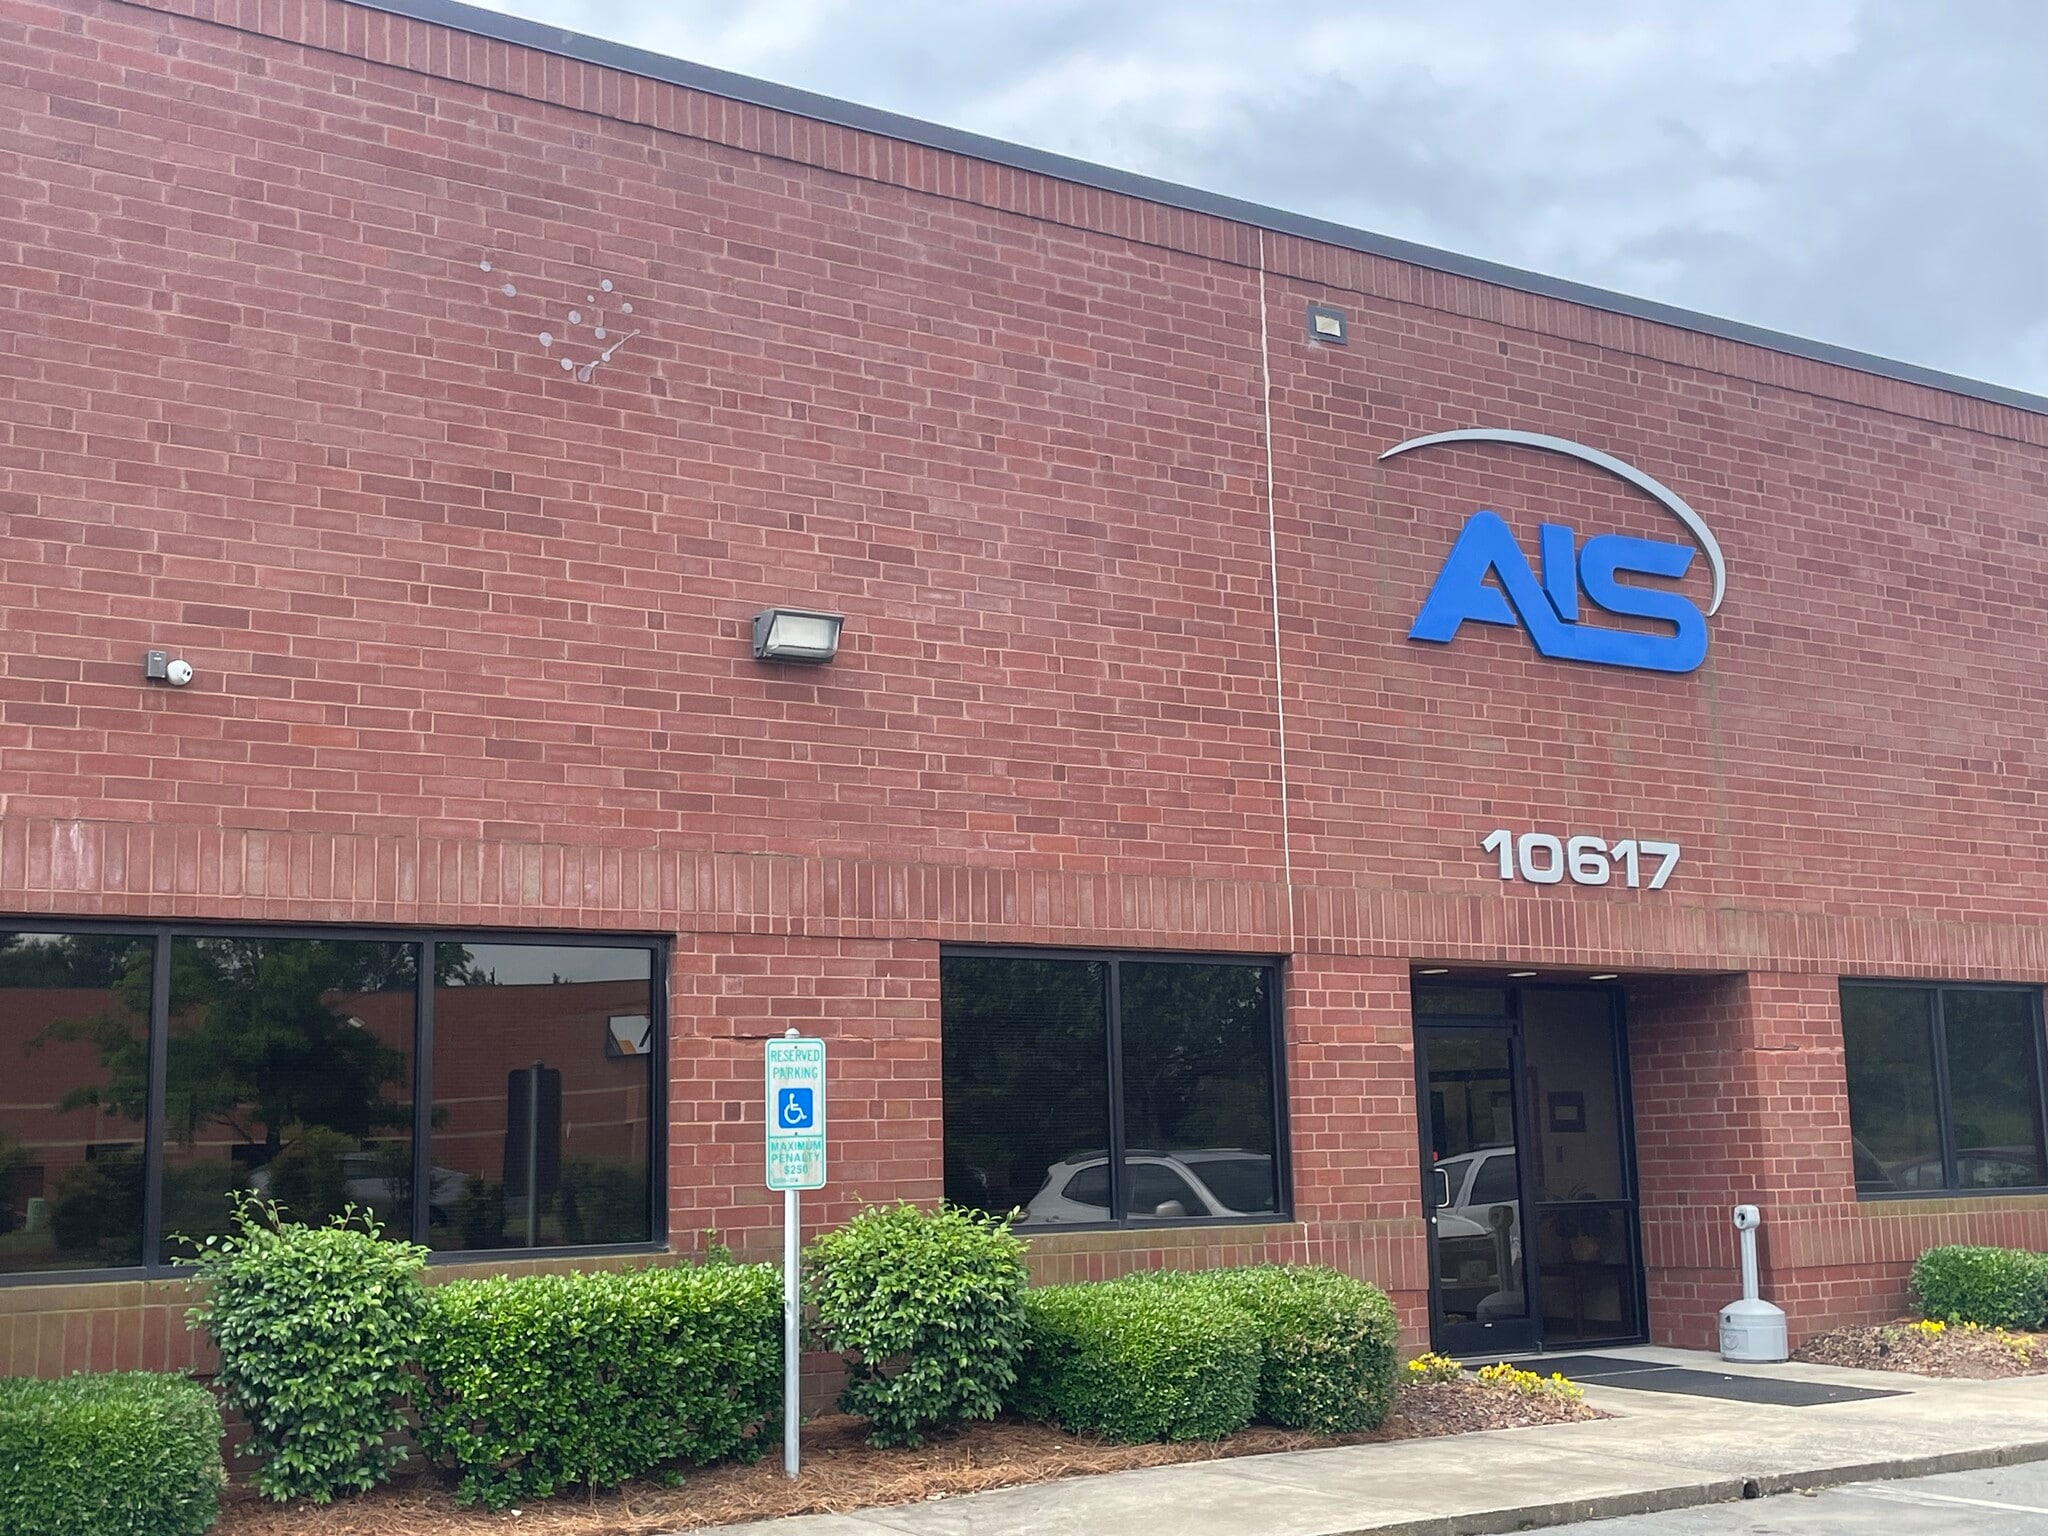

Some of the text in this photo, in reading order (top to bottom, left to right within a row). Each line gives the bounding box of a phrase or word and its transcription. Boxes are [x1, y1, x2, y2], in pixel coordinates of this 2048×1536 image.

[1407, 510, 1708, 673] AIS
[1480, 829, 1681, 890] 10617
[770, 1049, 820, 1062] RESERVED
[772, 1066, 818, 1079] PARKING
[771, 1140, 821, 1151] MAXIMUM
[771, 1153, 820, 1164] PENALTY
[783, 1165, 809, 1175] $250
